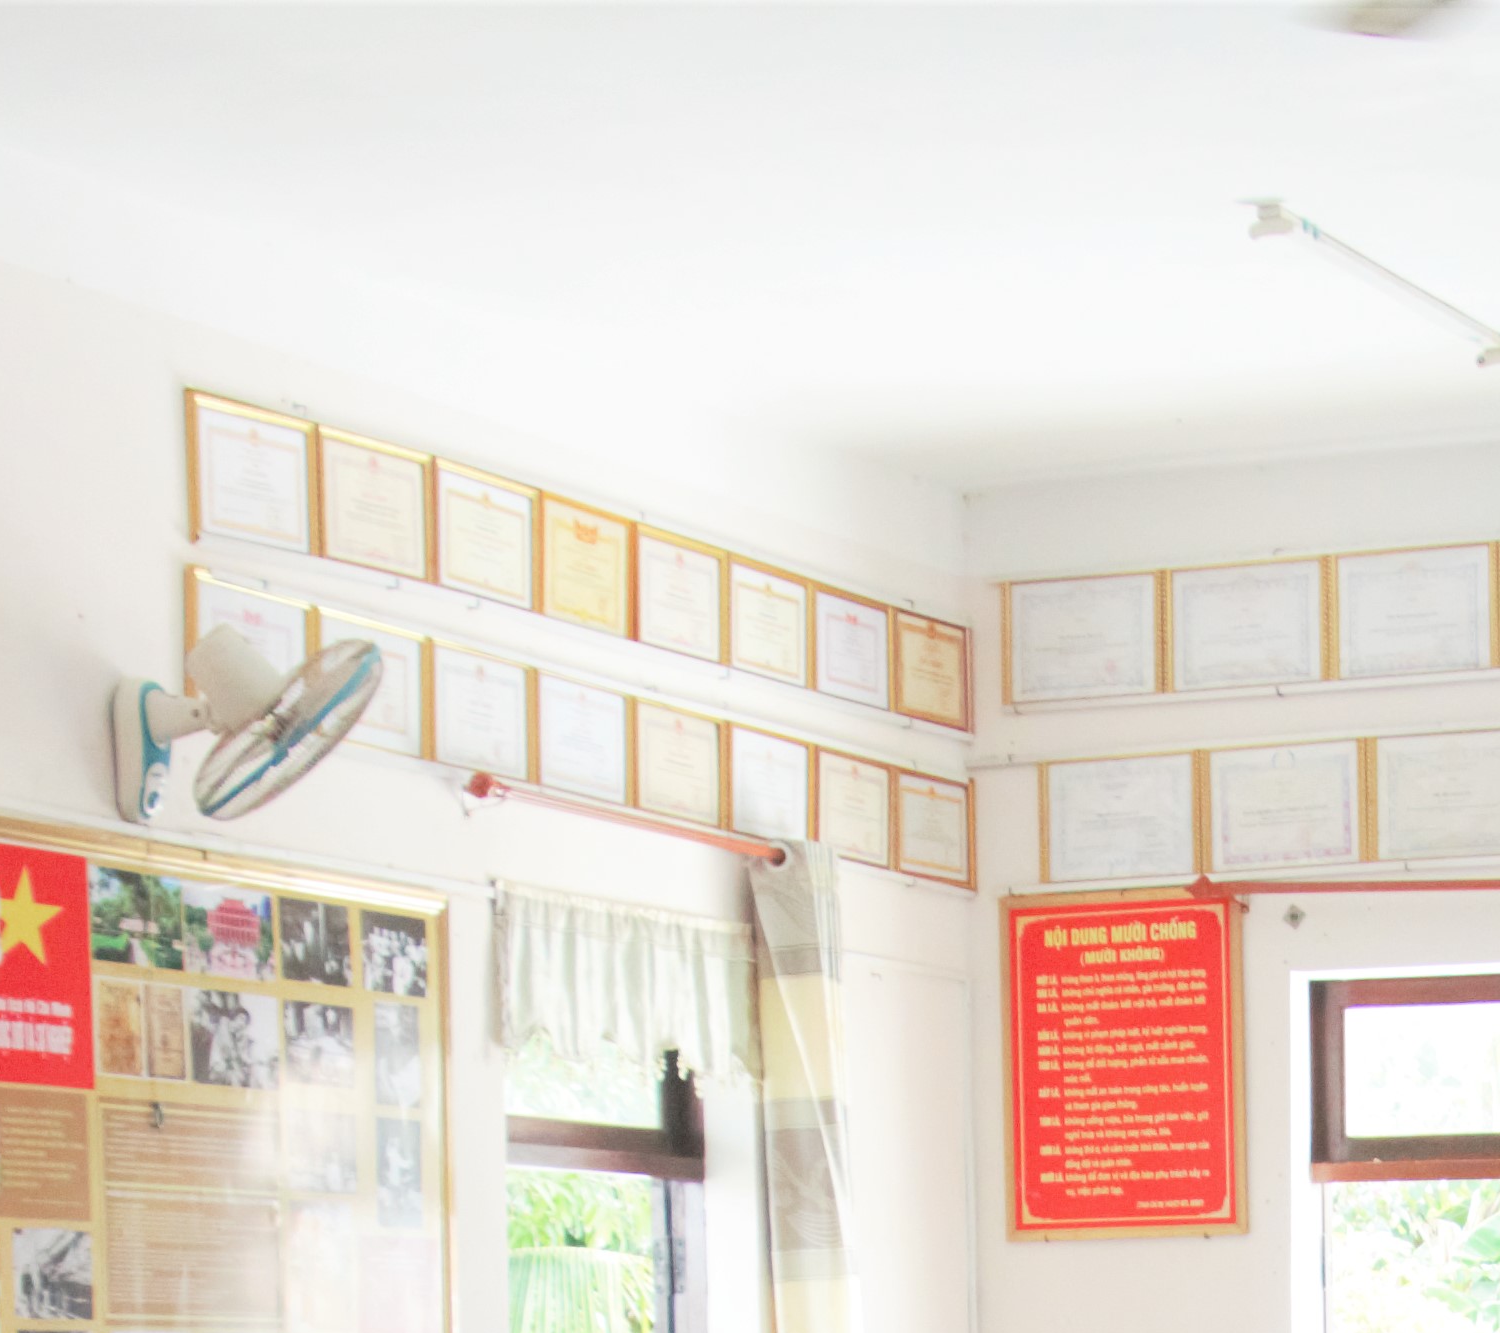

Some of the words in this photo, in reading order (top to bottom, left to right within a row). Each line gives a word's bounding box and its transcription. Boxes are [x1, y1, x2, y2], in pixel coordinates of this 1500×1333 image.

[1044, 925, 1068, 950] NỘI
[1071, 926, 1108, 946] DUNG
[1111, 920, 1147, 943] MƯỜI
[1150, 916, 1197, 941] CHỐNG
